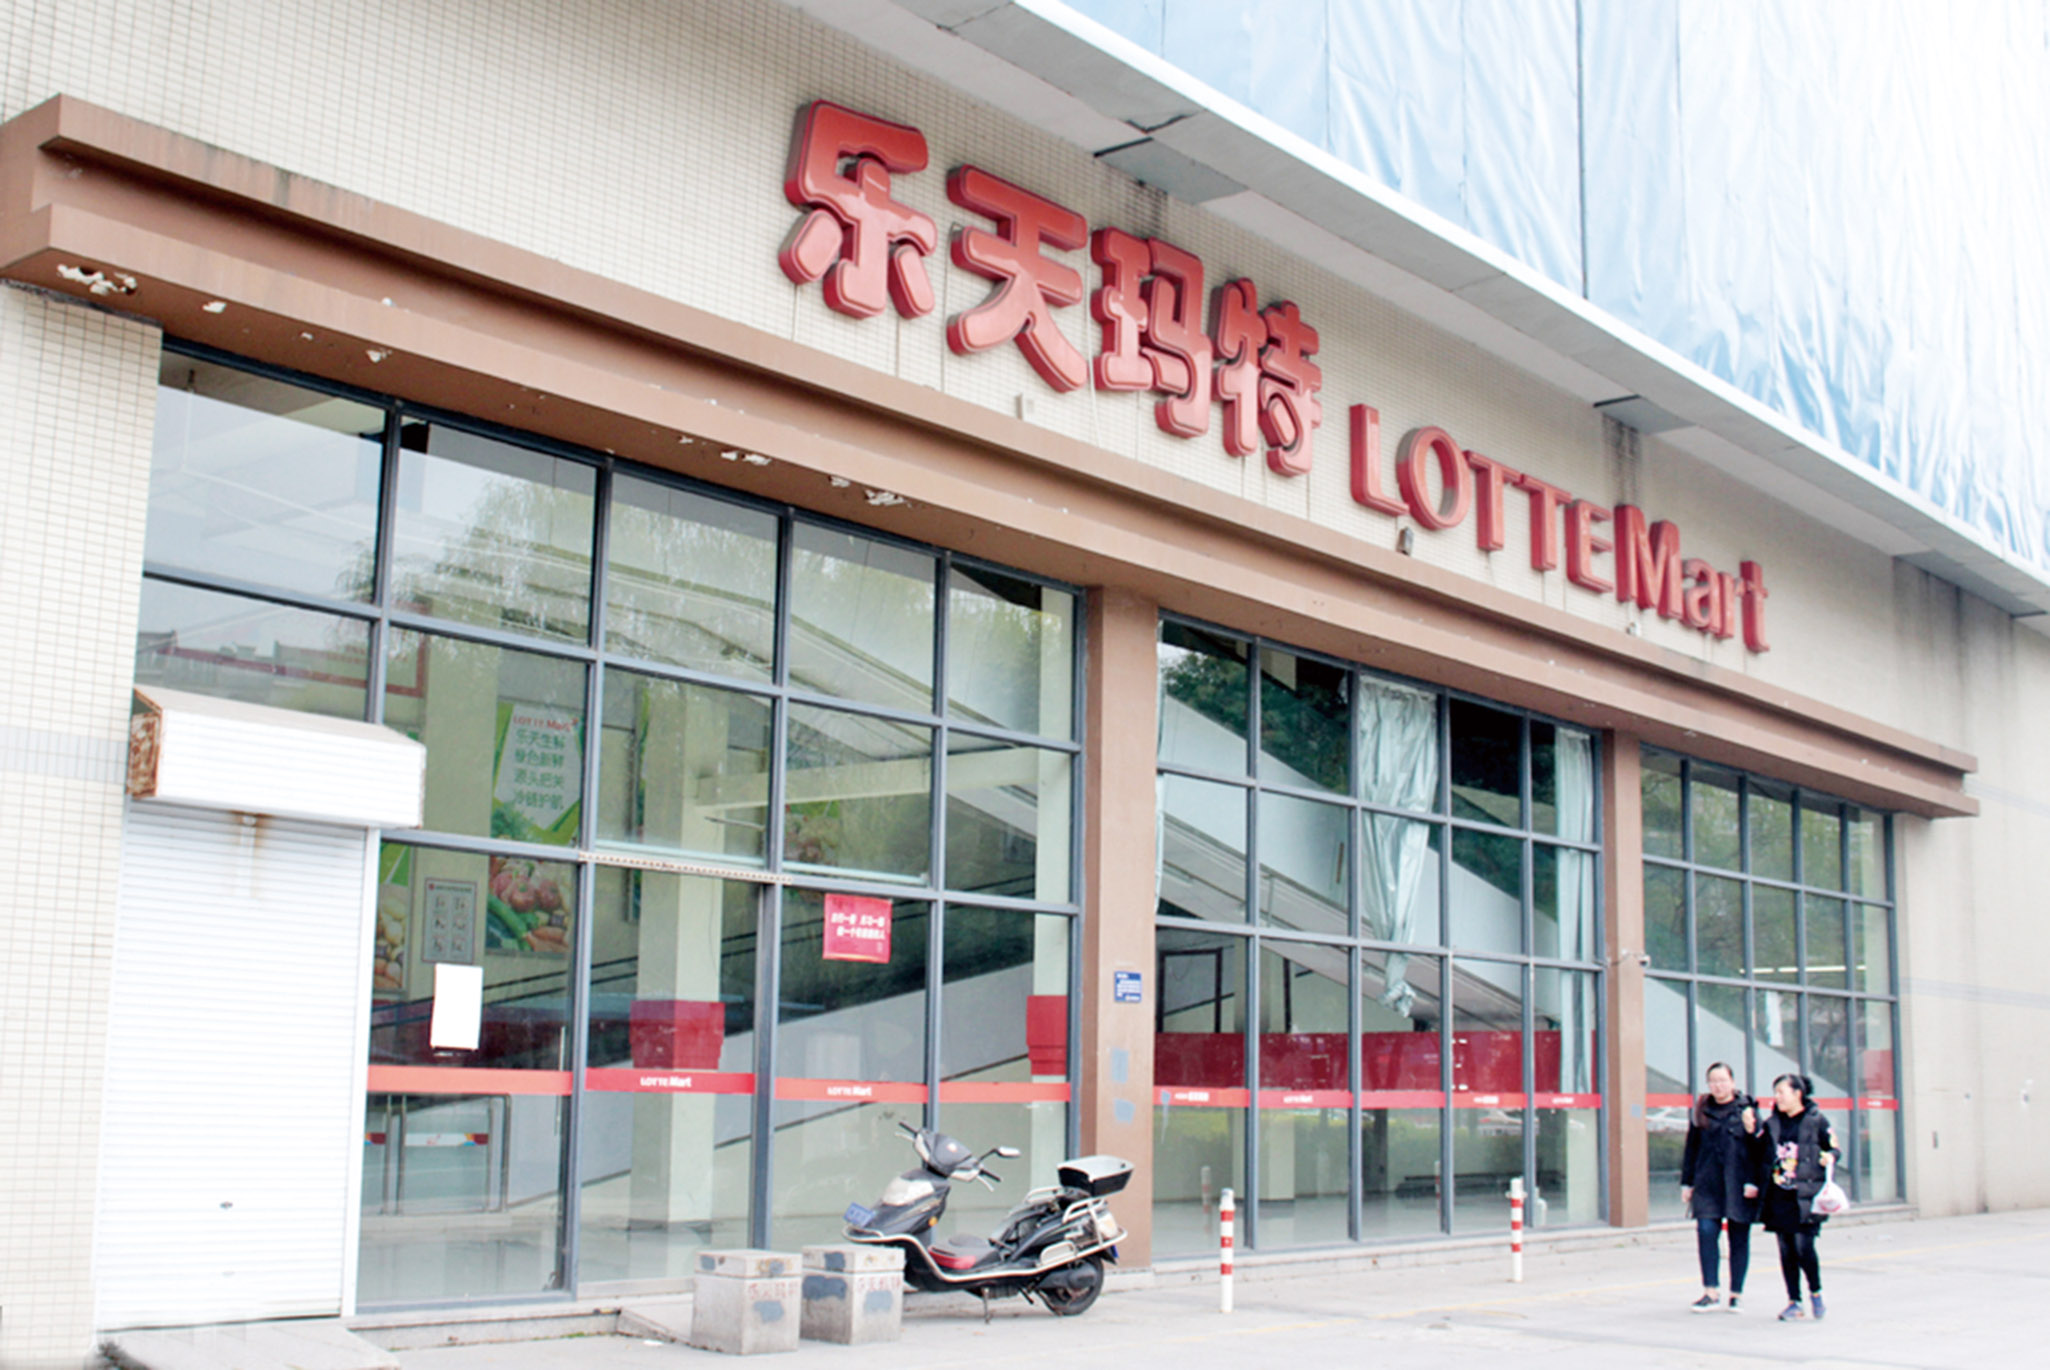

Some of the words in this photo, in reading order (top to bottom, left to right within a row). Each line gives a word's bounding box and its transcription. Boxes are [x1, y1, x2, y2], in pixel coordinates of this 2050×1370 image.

[779, 100, 1322, 476] 乐天玛特
[1350, 404, 1613, 593] LOTTE
[1614, 504, 1770, 653] Mart
